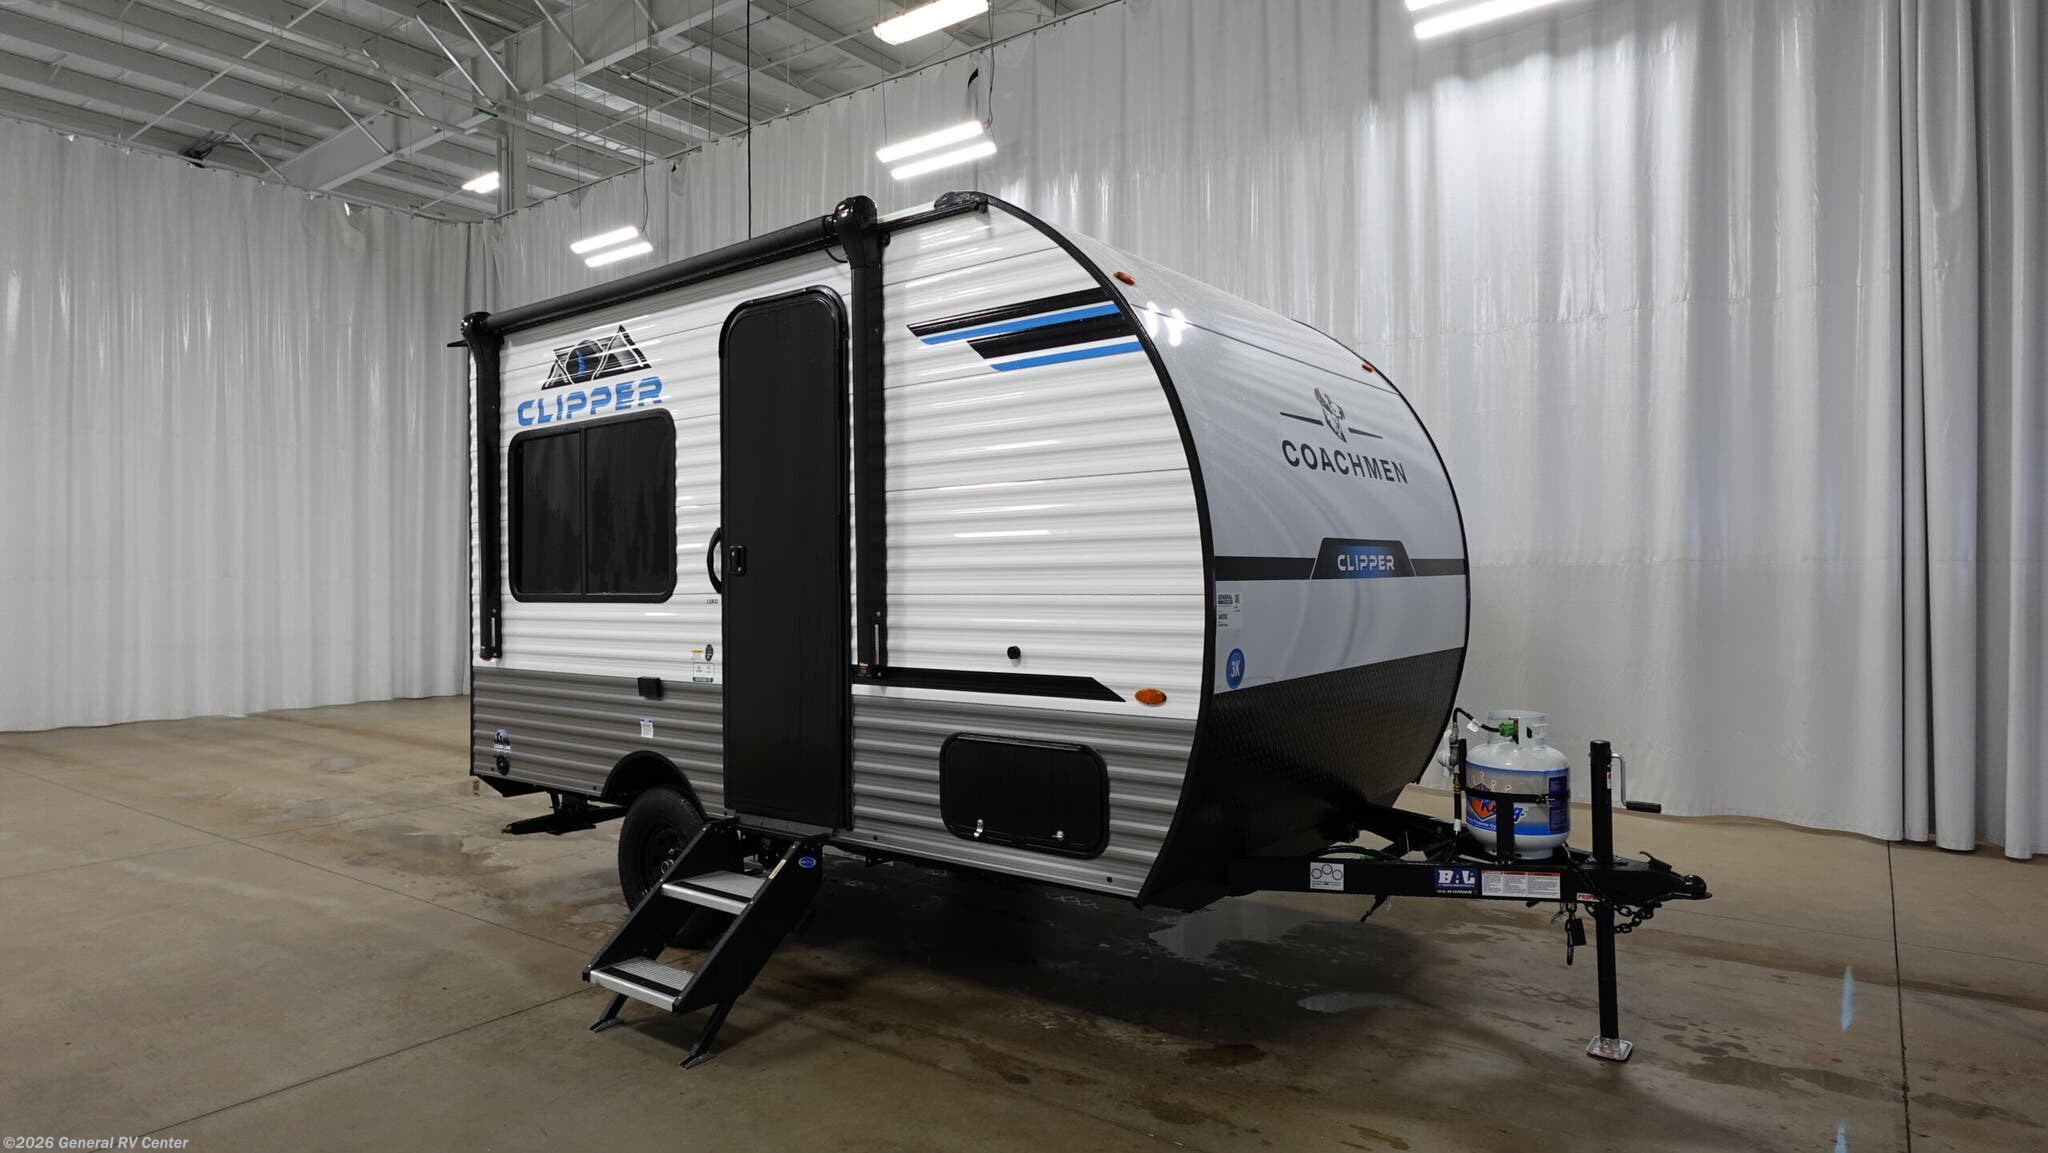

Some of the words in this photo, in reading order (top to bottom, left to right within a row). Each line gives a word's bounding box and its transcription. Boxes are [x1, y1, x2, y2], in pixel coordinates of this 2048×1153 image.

[517, 376, 663, 426] CLIPPER
[1281, 439, 1408, 484] COACHMEN
[1337, 553, 1395, 571] CLIPPER
[1230, 659, 1241, 678] 3K
